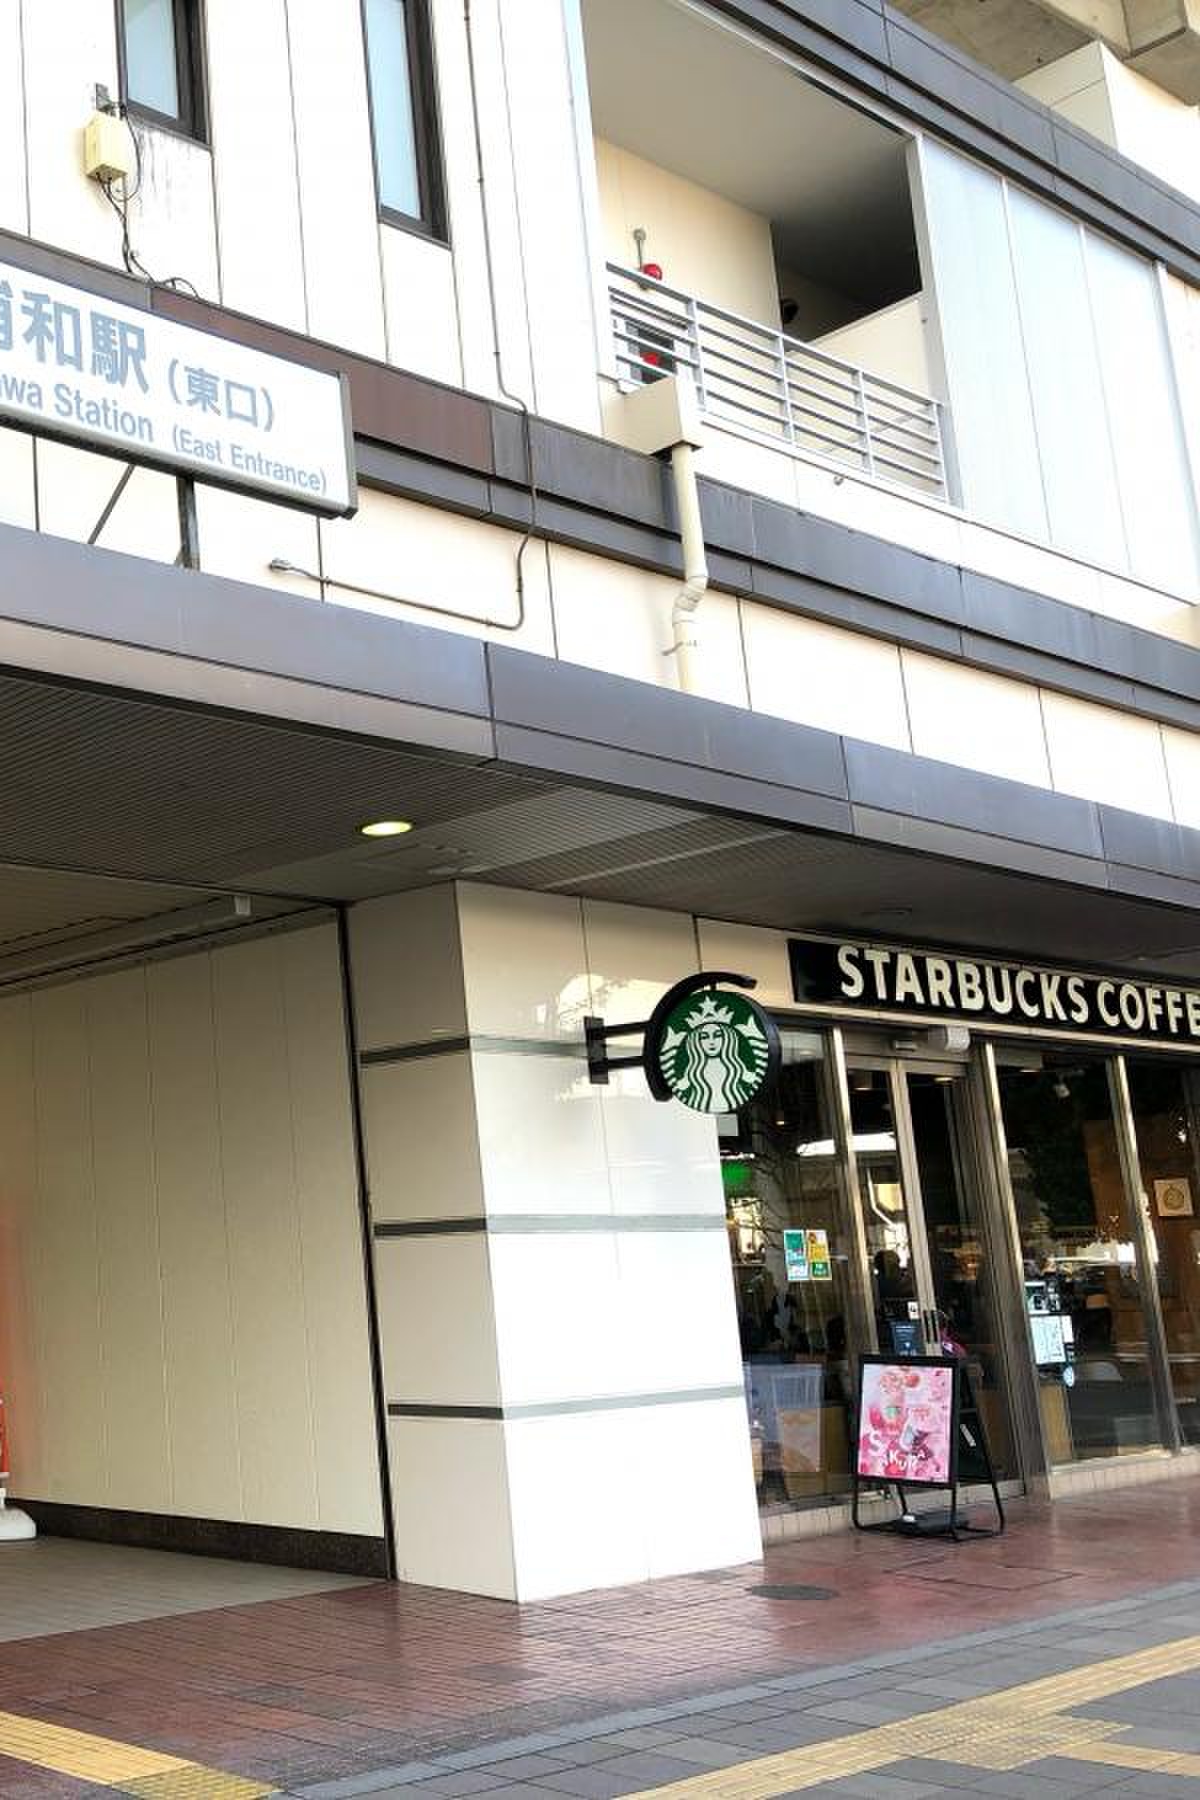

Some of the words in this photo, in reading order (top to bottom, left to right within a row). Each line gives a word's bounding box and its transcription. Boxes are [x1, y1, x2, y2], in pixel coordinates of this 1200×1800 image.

[54, 382, 154, 443] Station
[172, 425, 225, 466] (East
[230, 445, 327, 495] Entrance)
[837, 945, 1089, 1025] STARBUCKS
